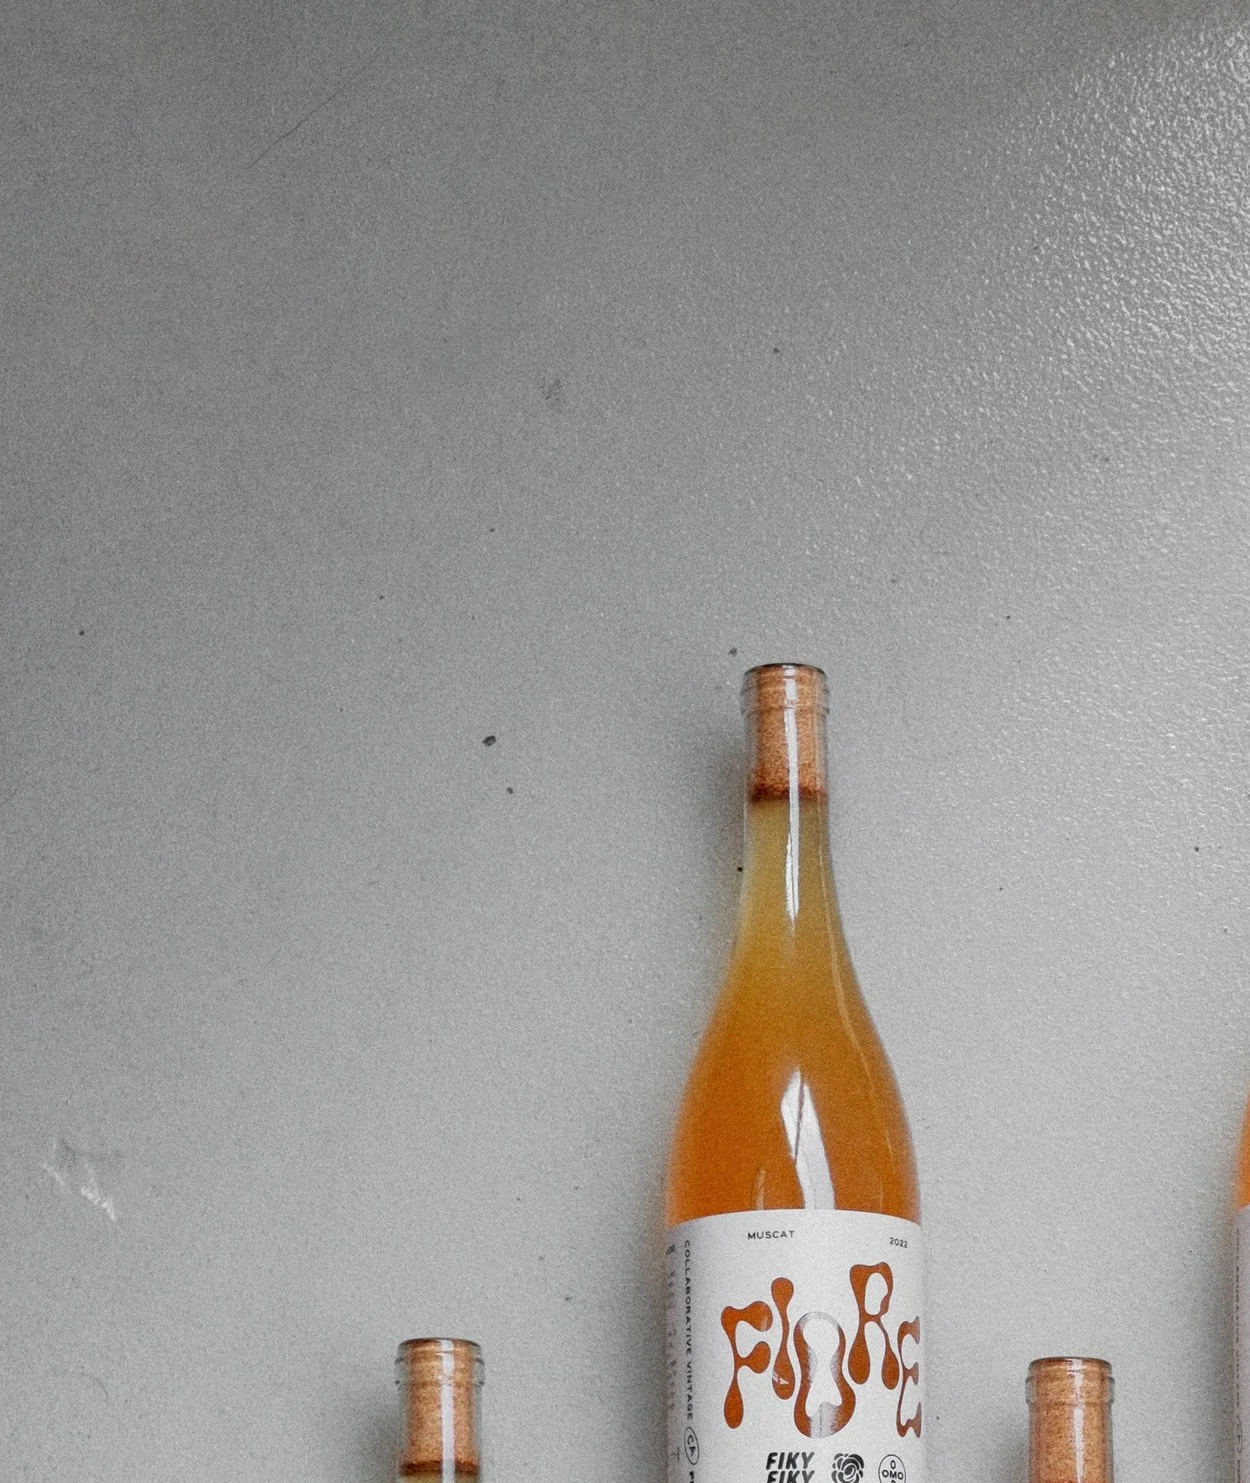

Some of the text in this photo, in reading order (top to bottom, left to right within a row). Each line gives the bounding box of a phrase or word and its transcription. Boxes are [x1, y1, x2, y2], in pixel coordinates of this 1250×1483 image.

[748, 1231, 794, 1239] MUSCAT
[890, 1237, 907, 1248] 2022
[684, 1240, 692, 1356] COLLABORATIVE
[766, 1452, 814, 1470] FIKY
